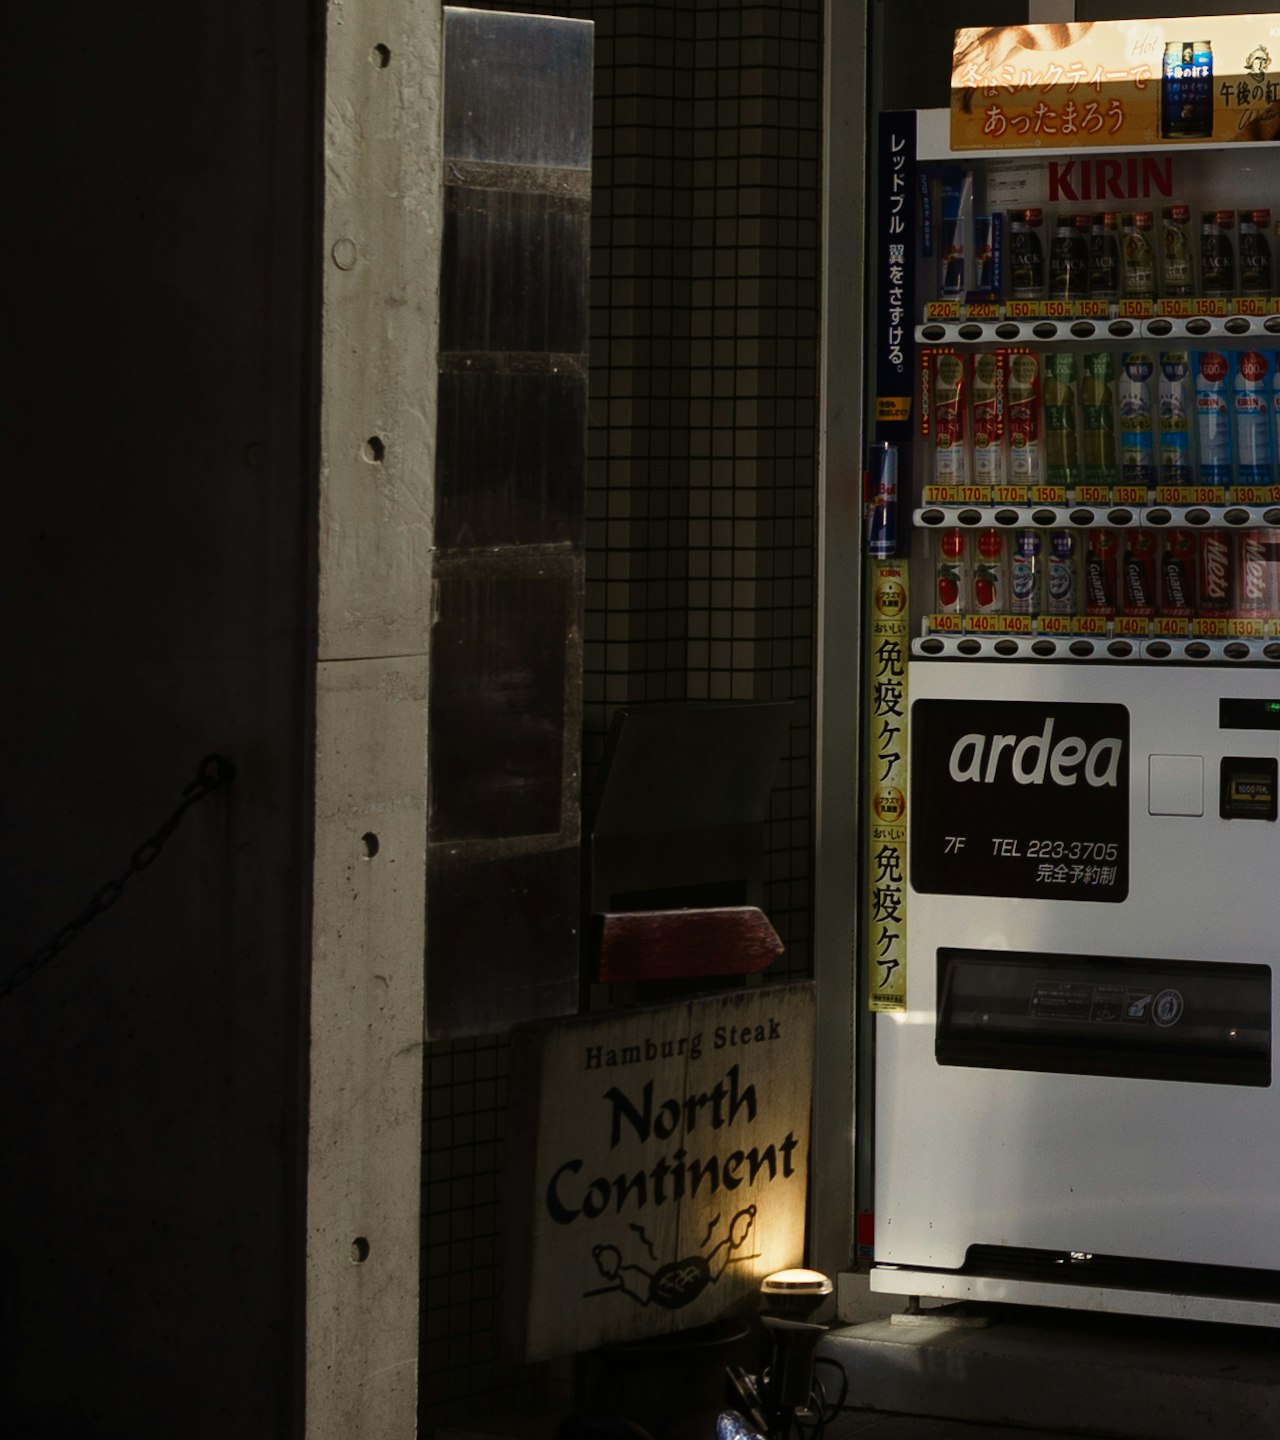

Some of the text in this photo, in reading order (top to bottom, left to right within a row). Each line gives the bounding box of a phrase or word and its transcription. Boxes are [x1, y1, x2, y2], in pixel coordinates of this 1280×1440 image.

[957, 62, 1153, 97] 冬はミルクティーで
[983, 101, 1126, 137] あったまろう
[1048, 156, 1174, 202] KIRIN
[888, 133, 906, 371] レッドブル 翼をさずける。
[930, 302, 957, 317] 220円
[968, 302, 997, 317] 220円
[1009, 302, 1036, 316] 150円
[1045, 302, 1071, 316] 150円
[1080, 301, 1106, 315] 150円
[1123, 301, 1149, 314] 150円
[1160, 301, 1188, 314] 150円
[1196, 301, 1223, 314] 150円
[1236, 300, 1264, 314] 150円
[929, 487, 955, 501] 170円
[961, 487, 988, 501] 170円
[998, 487, 1025, 501] 170円
[1036, 488, 1063, 501] 150円
[1080, 488, 1107, 501] 150円
[1117, 488, 1145, 502] 130円
[1159, 488, 1187, 502] 130円
[1194, 488, 1223, 502] 130円
[1233, 488, 1262, 502] 130円
[1203, 537, 1229, 599] Mets
[874, 622, 906, 634] おいしい
[933, 616, 960, 630] 140円
[968, 616, 996, 630] 140円
[1002, 616, 1029, 630] 140円
[1041, 616, 1068, 631] 140円
[1076, 617, 1104, 632] 140円
[1119, 619, 1145, 633] 140円
[1158, 619, 1186, 633] 140円
[1196, 620, 1224, 634] 130円
[1232, 621, 1261, 635] 130円
[873, 637, 904, 782] 免疫ケア
[948, 717, 1123, 788] ardea
[873, 828, 905, 840] おいしい
[943, 836, 1119, 861] 7F TEL 223-3705
[1035, 863, 1118, 886] 完全予約制
[872, 844, 903, 989] 免疫ケア
[584, 1017, 782, 1072] Hamburg Steak
[603, 1063, 760, 1150] North
[546, 1130, 800, 1227] Continent
